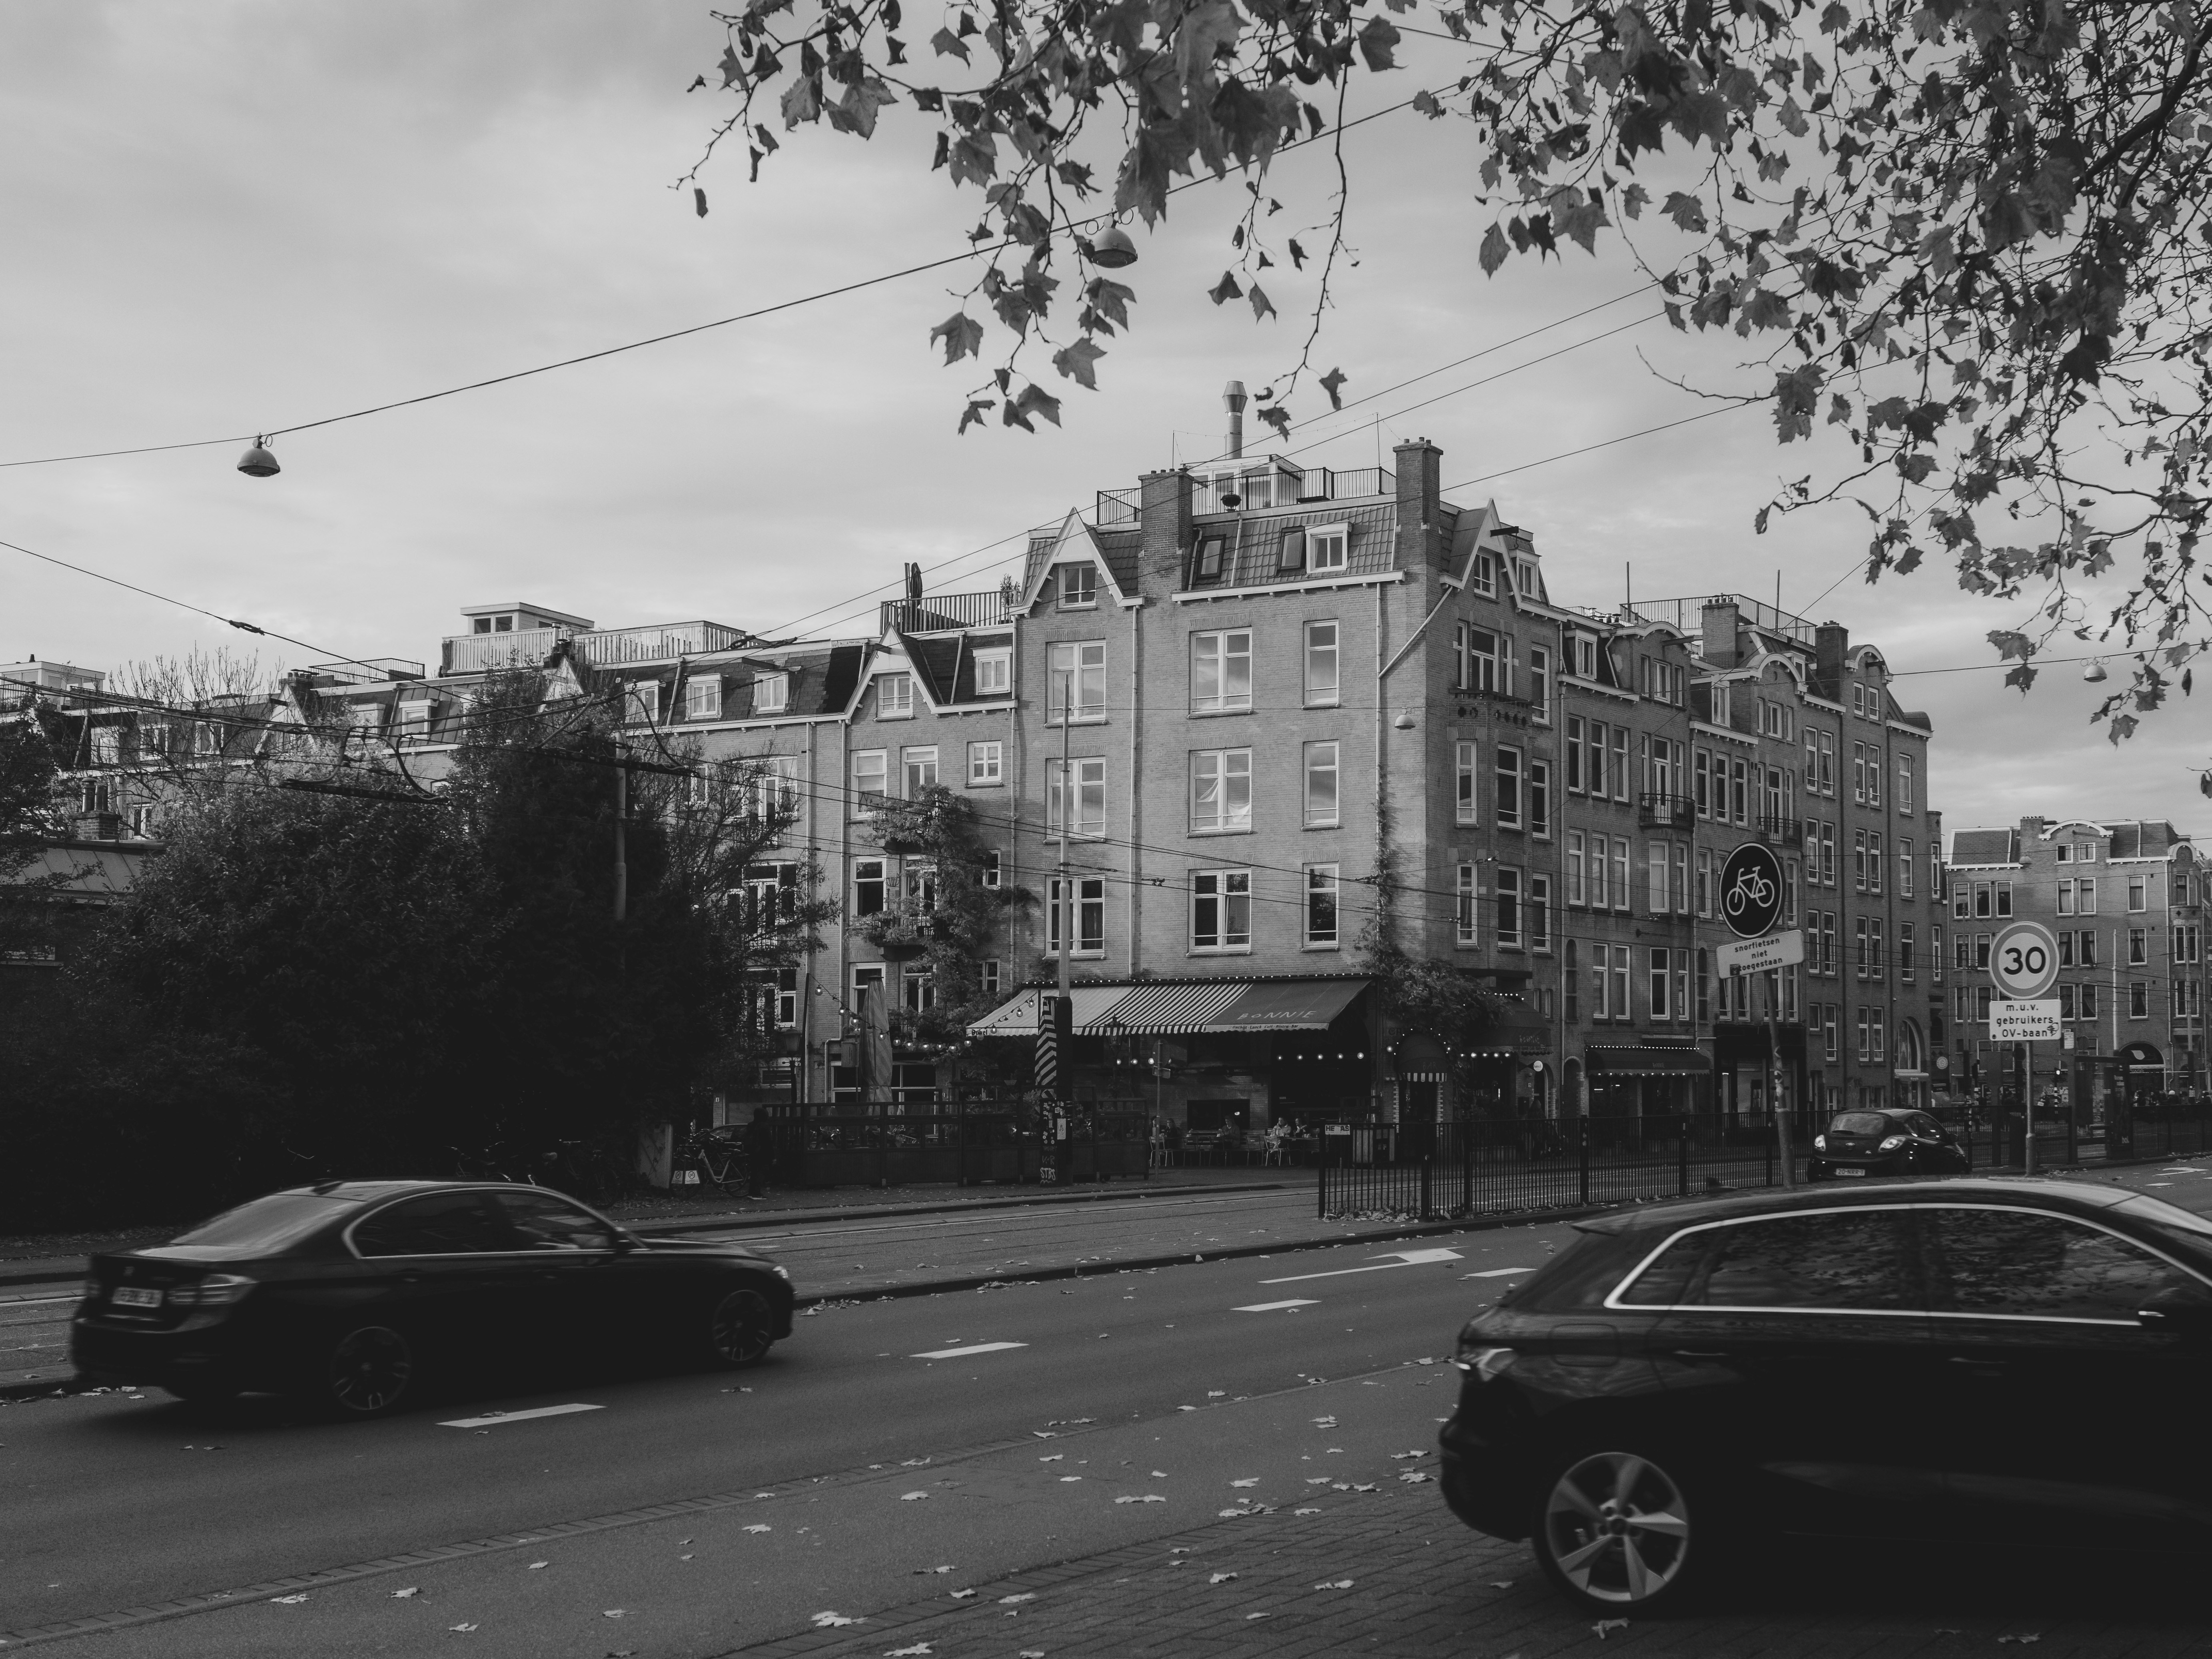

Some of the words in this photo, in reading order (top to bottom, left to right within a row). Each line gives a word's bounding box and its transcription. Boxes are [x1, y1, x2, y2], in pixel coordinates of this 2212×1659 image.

[1735, 938, 1780, 952] snorfietsen
[1751, 950, 1767, 958] niet
[1739, 958, 1783, 971] toegestaan
[2004, 946, 2046, 975] 30
[1237, 1011, 1316, 1020] BONNIE
[1996, 1016, 2053, 1027] gebruikers
[2002, 1029, 2047, 1037] OV-baan
[1423, 1062, 1437, 1070] BAR
